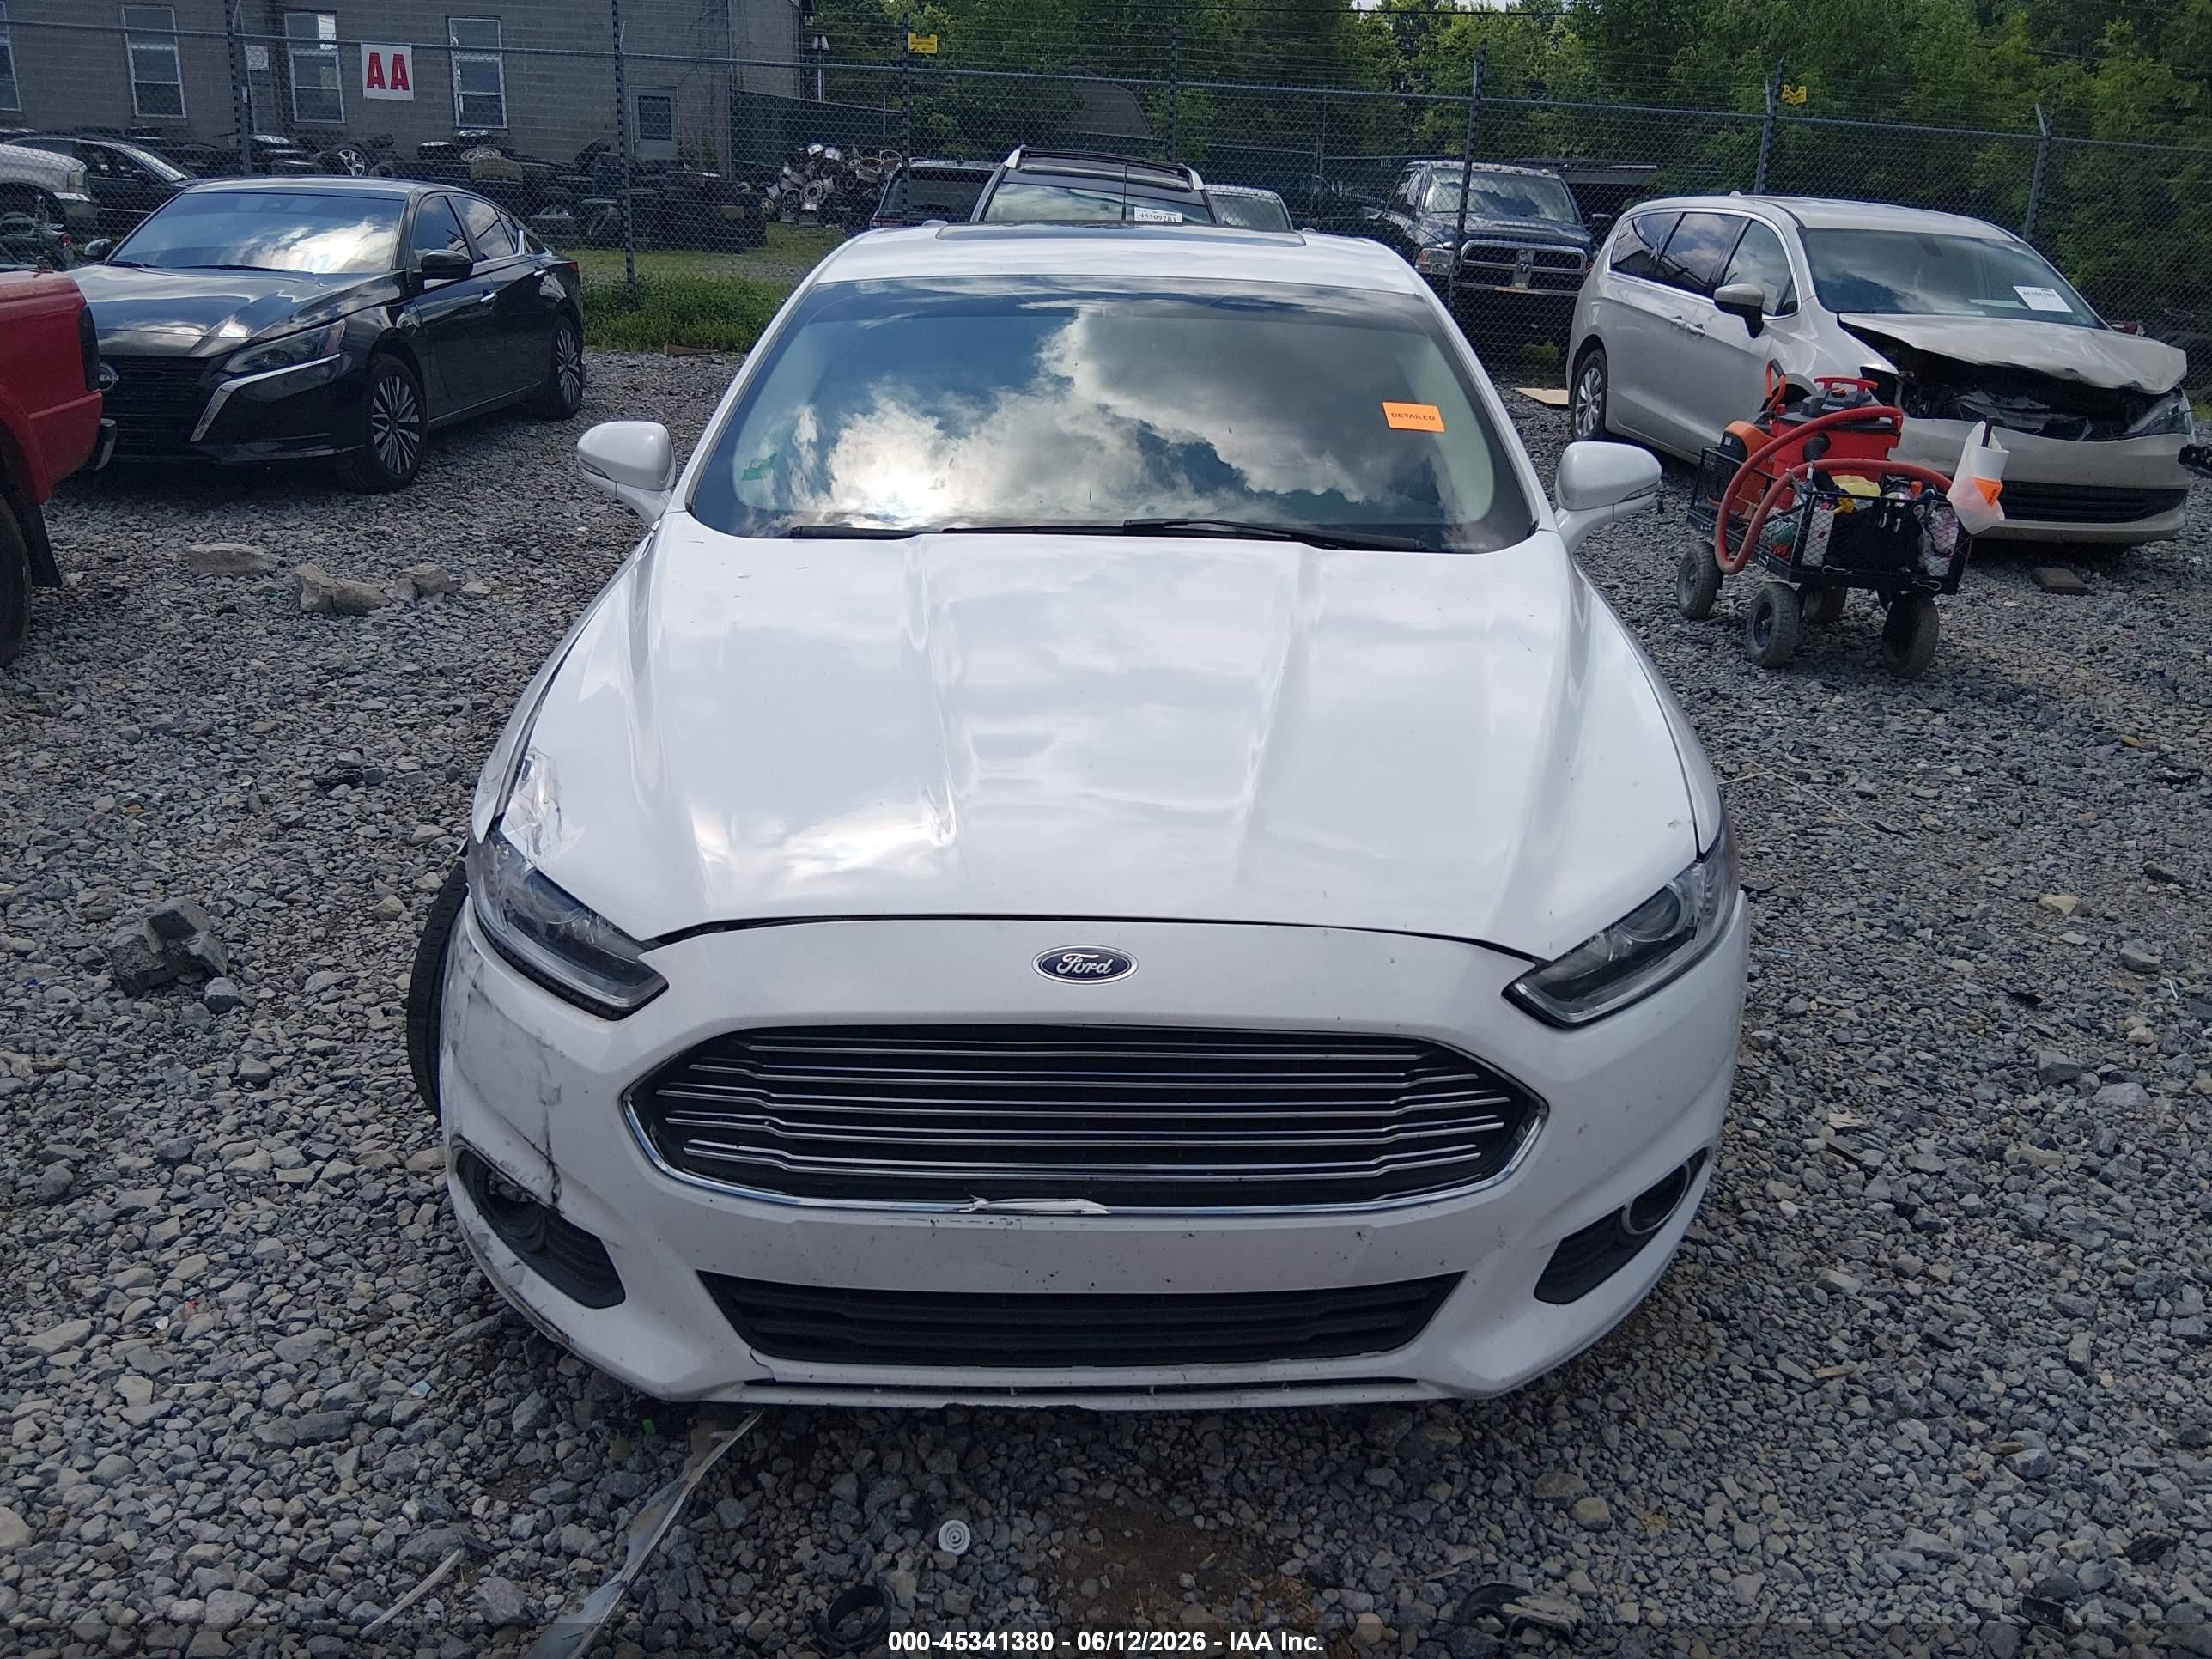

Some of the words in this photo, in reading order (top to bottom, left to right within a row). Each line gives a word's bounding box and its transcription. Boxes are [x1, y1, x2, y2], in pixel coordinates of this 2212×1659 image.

[367, 52, 410, 90] AA
[1391, 412, 1435, 421] DETAILED
[1056, 953, 1114, 975] Ford
